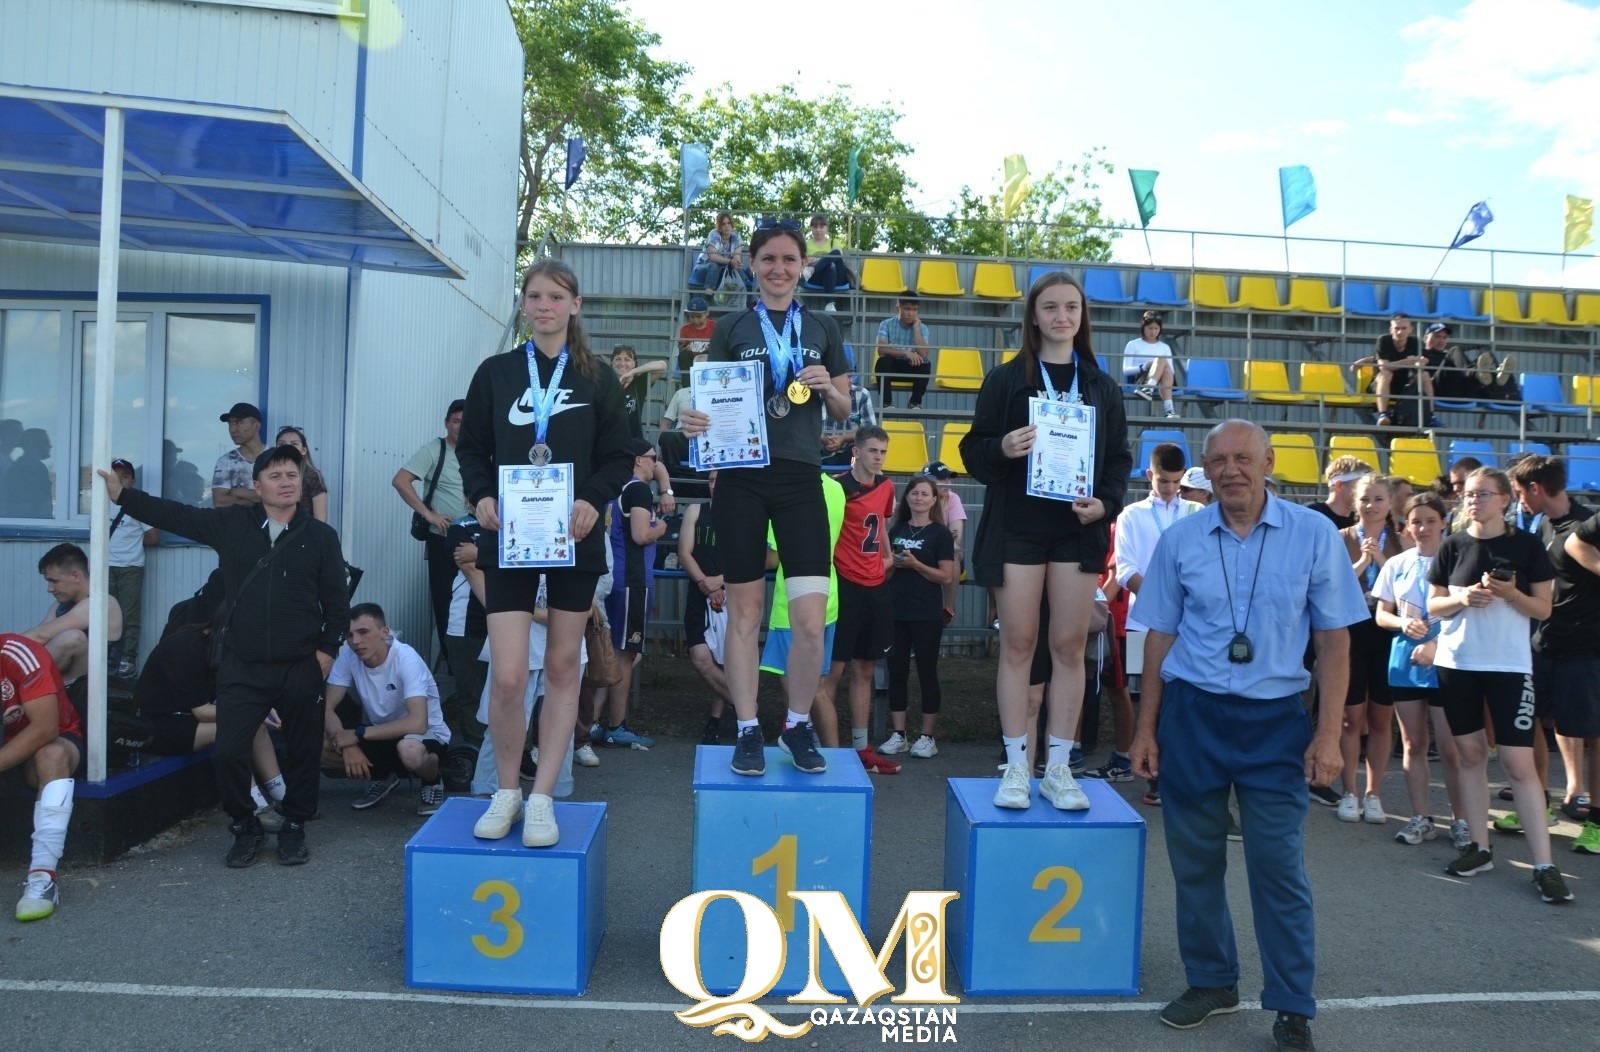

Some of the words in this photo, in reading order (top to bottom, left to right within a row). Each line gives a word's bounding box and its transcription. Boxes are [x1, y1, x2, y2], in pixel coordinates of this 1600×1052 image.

[740, 347, 821, 360] YOUTER
[519, 387, 574, 407] NE
[1049, 429, 1078, 440] Диплом
[862, 512, 880, 554] 2
[752, 834, 798, 932] 1
[1028, 865, 1083, 943] 2
[471, 879, 524, 959] 3
